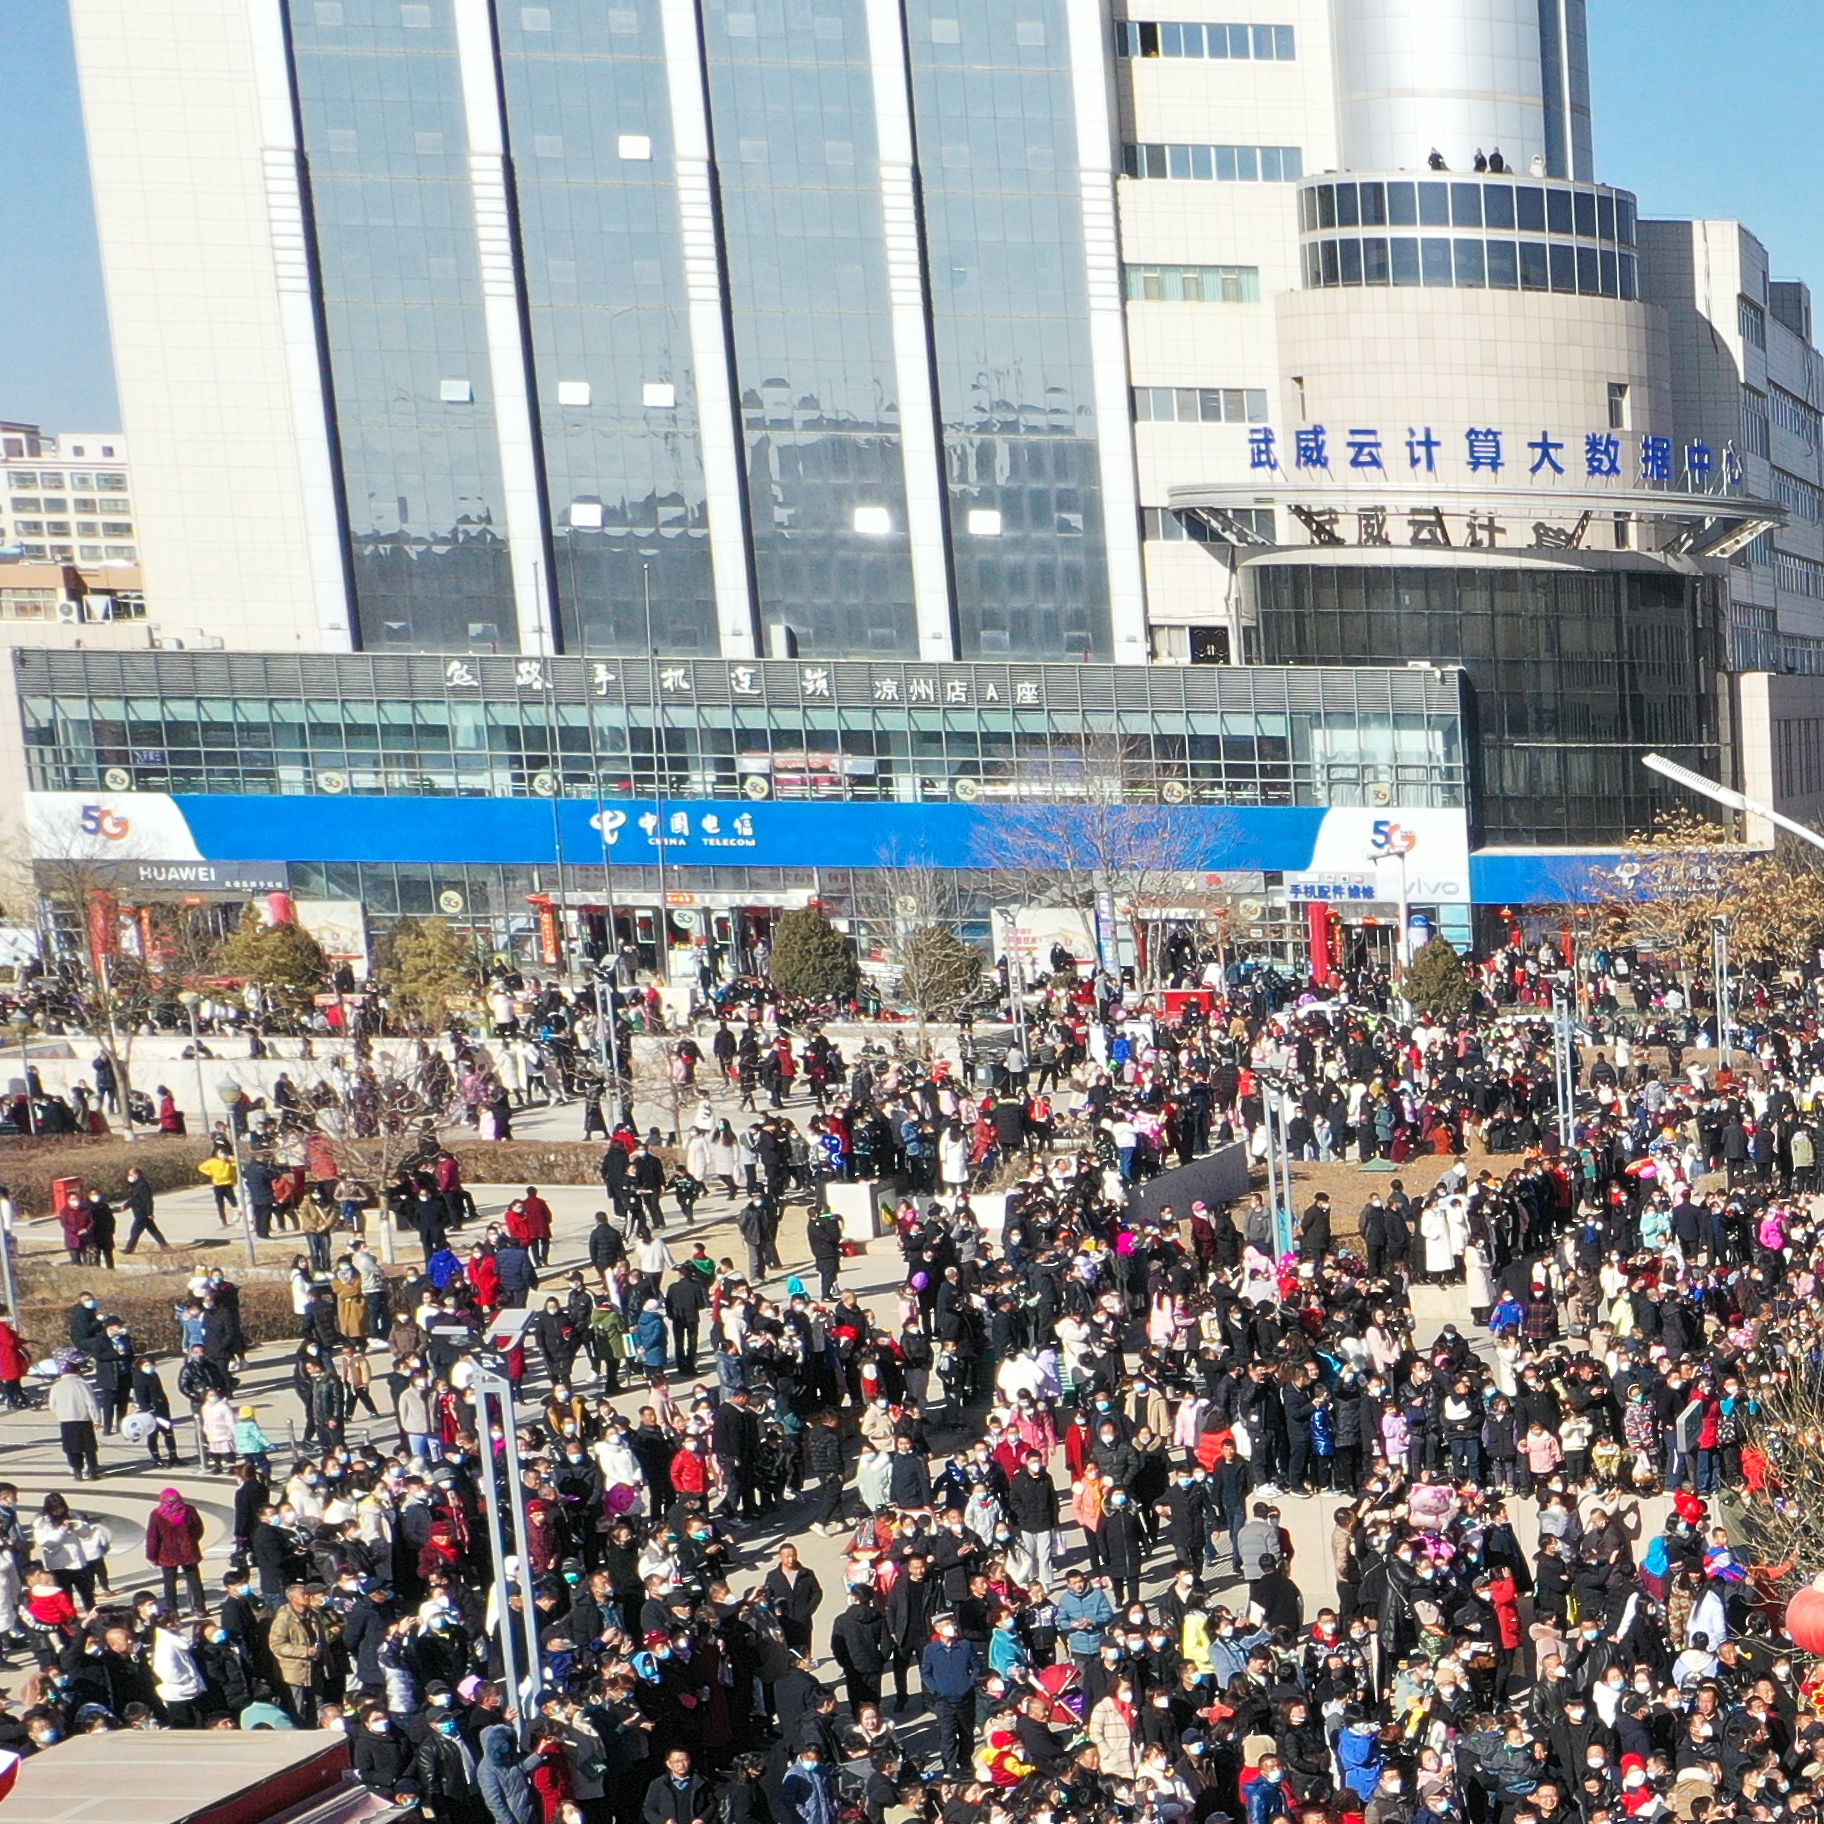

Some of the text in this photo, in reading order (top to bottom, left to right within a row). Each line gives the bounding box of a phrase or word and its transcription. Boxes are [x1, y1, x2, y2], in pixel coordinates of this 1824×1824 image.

[1249, 426, 1744, 486] 武威云计算大数据中心
[874, 678, 1040, 704] 凉州店A座
[80, 805, 131, 840] 5G
[638, 811, 755, 837] 中国电信
[1370, 820, 1417, 851] 5G
[138, 866, 217, 882] HUAWEI
